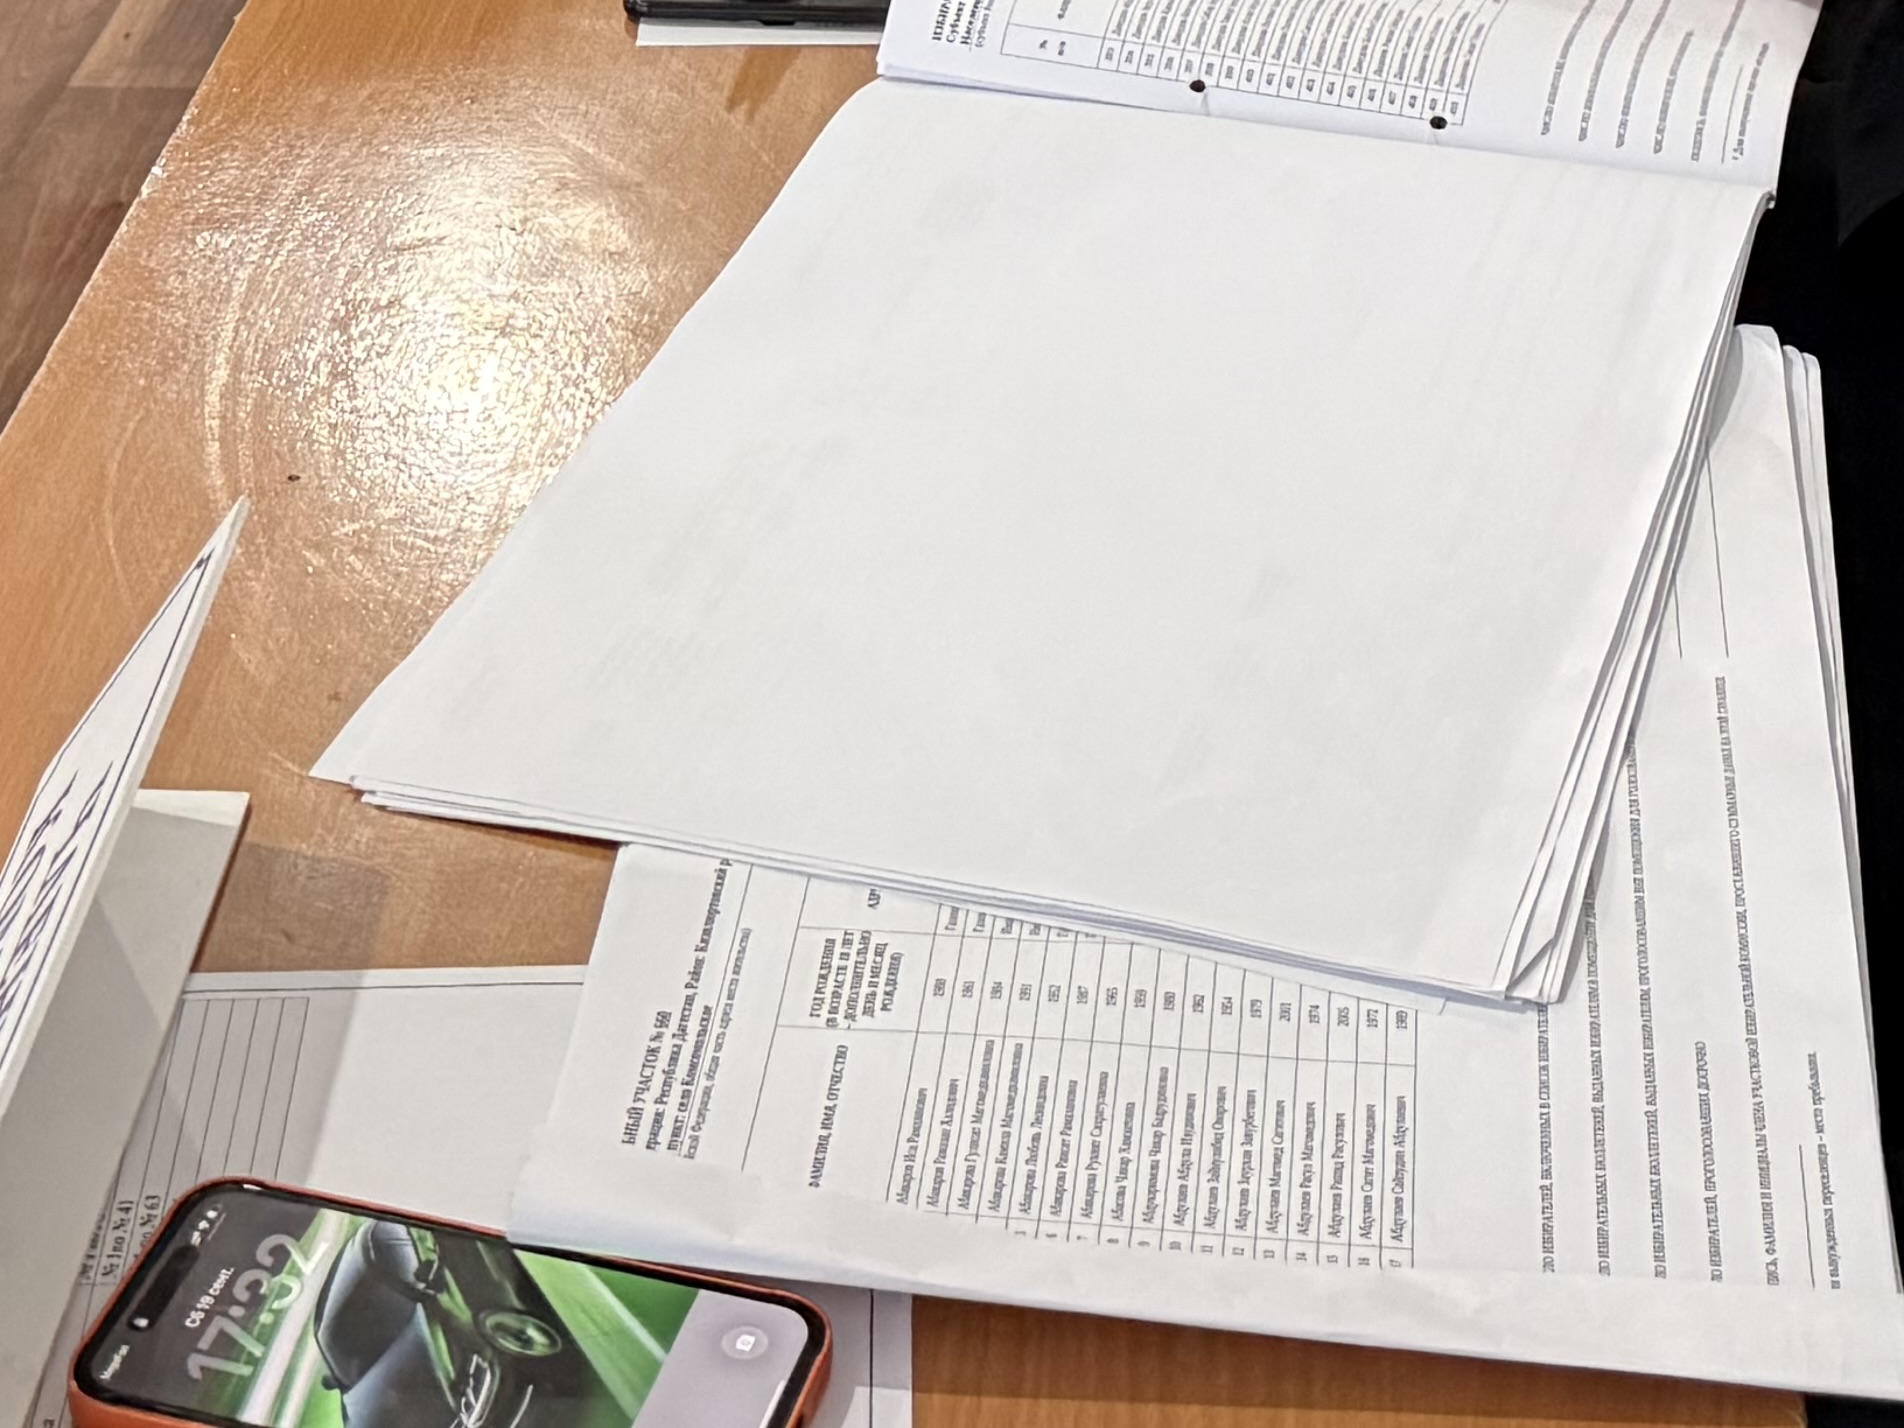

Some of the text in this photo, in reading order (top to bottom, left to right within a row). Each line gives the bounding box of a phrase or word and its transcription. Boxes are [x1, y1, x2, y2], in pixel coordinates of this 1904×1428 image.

[632, 1045, 661, 1103] УЧАСТОК
[653, 1043, 682, 1105] Республика
[187, 1233, 330, 1380] 17:32
